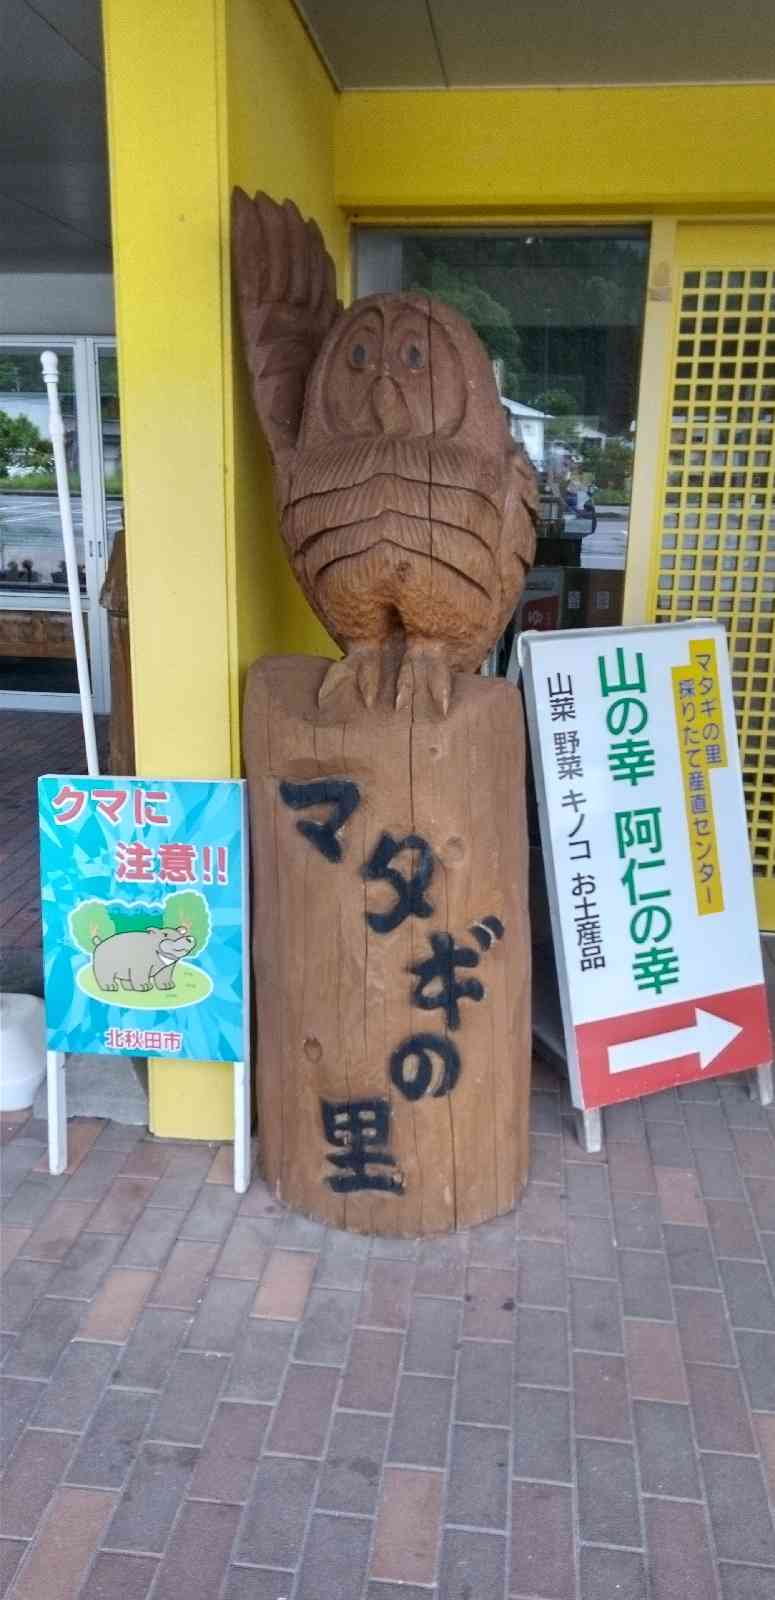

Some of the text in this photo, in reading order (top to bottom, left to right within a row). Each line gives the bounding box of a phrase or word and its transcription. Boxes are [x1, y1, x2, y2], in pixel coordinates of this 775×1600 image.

[679, 678, 713, 905] 採りたて産直センター
[695, 653, 722, 764] マタギの里
[52, 786, 168, 824] クマに
[115, 842, 228, 884] 注意!!
[547, 672, 606, 972] 山菜 野菜 キノコ お土産品
[598, 647, 680, 995] 山の幸 阿仁の幸
[105, 1029, 182, 1051] 北秋田市
[279, 779, 504, 1196] マタギの里
